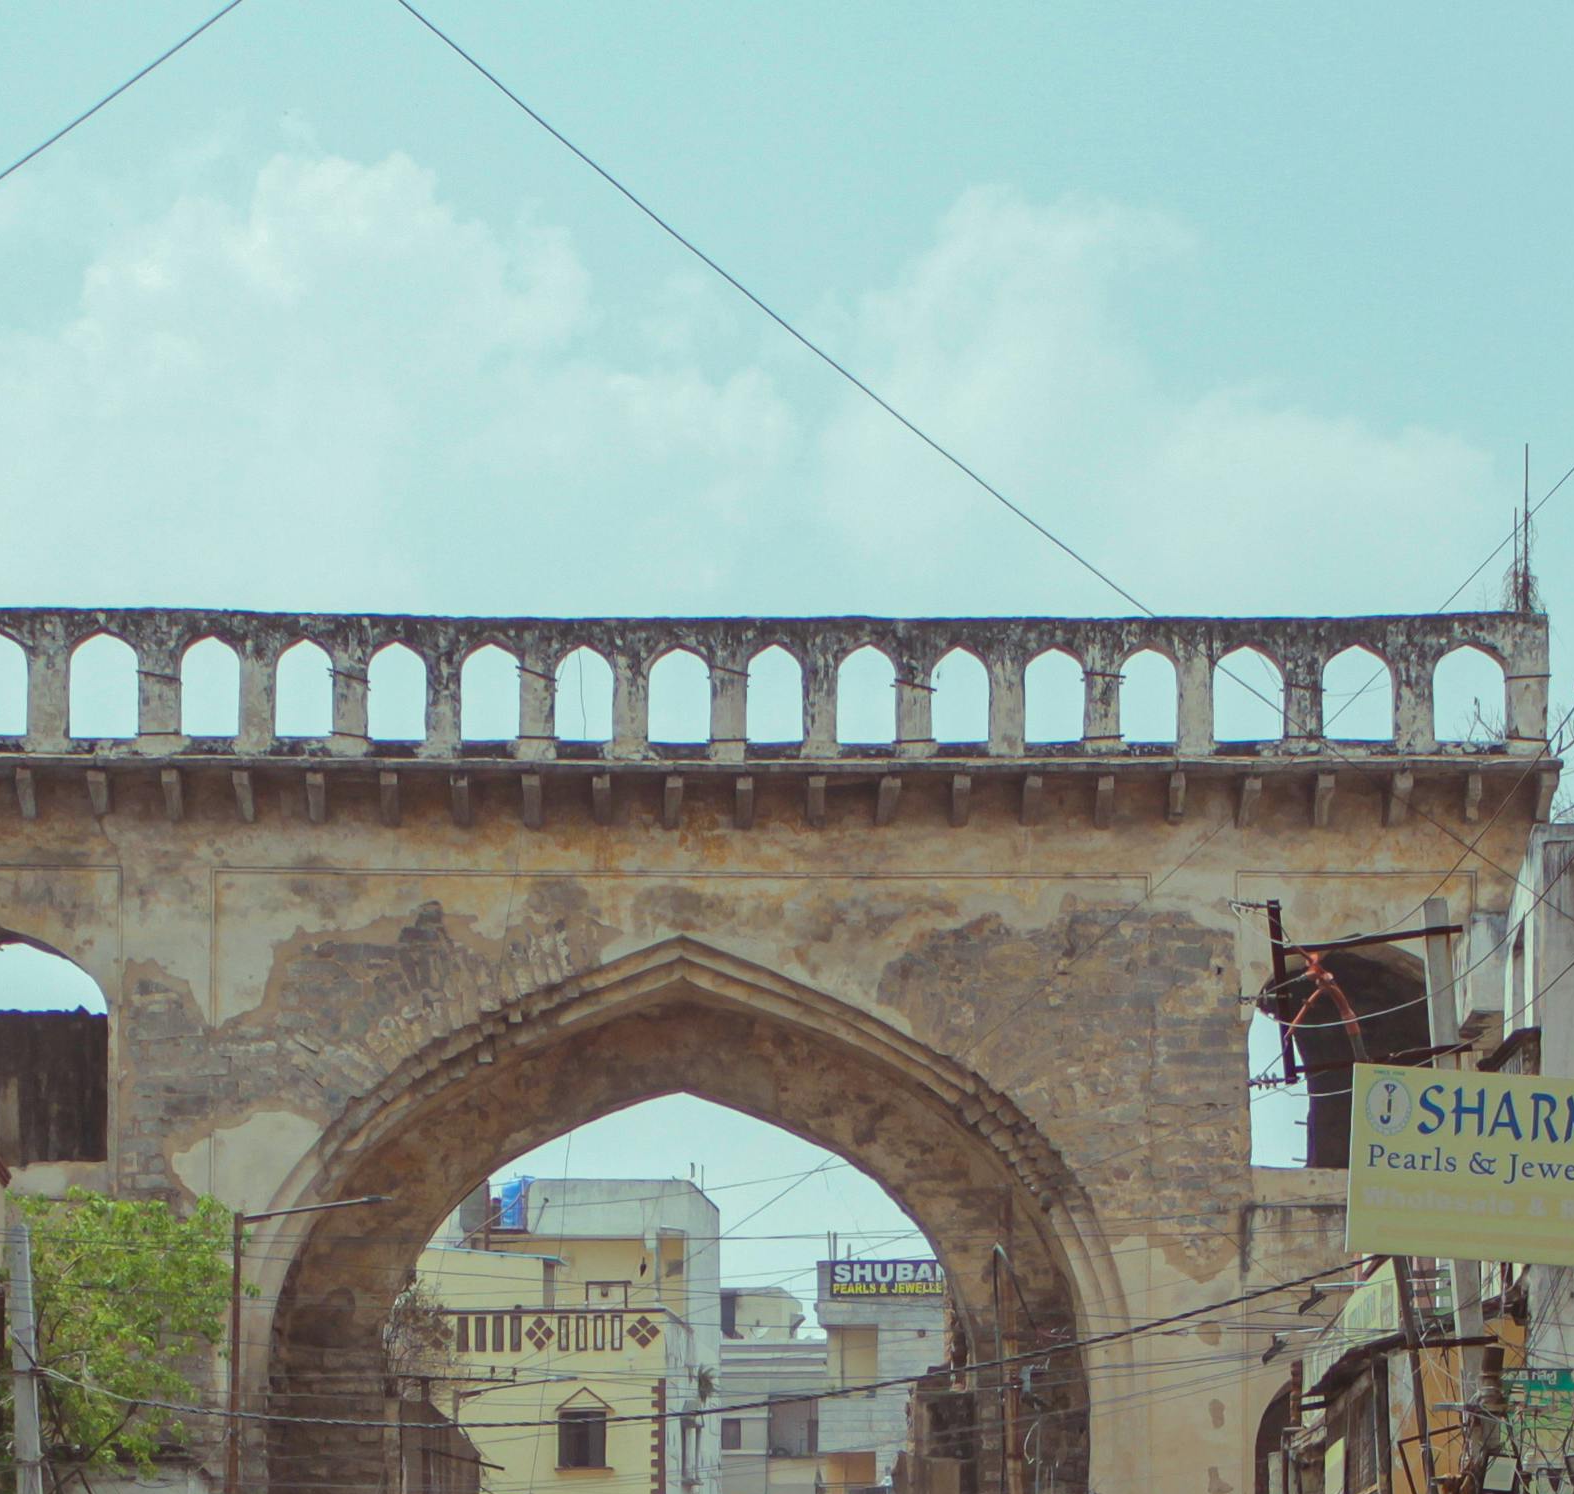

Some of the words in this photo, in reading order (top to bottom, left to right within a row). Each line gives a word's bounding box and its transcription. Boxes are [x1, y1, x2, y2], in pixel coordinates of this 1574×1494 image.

[1368, 1144, 1457, 1173] Pearls
[1469, 1152, 1497, 1175] &
[833, 1283, 876, 1294] PEARLS
